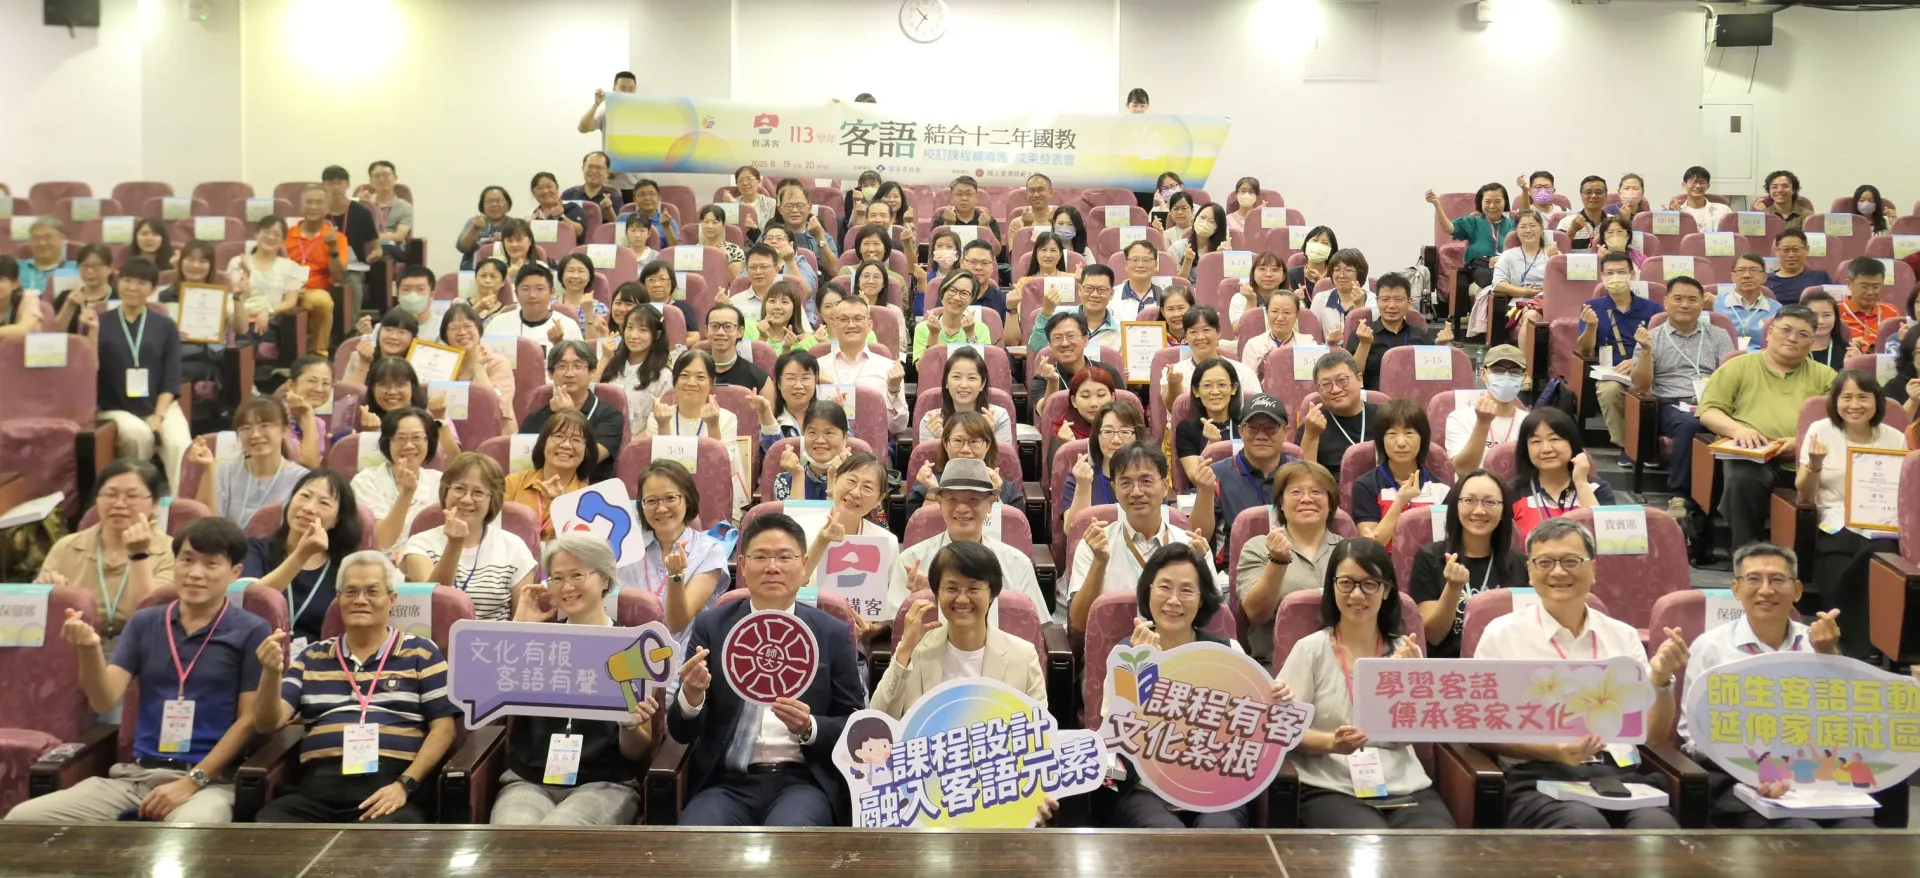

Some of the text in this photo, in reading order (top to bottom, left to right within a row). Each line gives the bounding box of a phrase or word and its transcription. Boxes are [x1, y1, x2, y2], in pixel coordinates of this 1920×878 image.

[839, 119, 917, 158] 客語
[923, 124, 1076, 150] 結合十二年國教
[1423, 356, 1442, 364] 5-15
[666, 445, 684, 455] 3-9
[1717, 607, 1746, 621] 保留
[470, 637, 572, 667] 文化有根
[763, 647, 778, 668] 師大
[496, 665, 598, 694] 客語有聲
[1375, 671, 1498, 700] 學習客語
[1707, 673, 1920, 715] 師生客語互動
[1144, 676, 1307, 747] 課程有客
[1388, 700, 1575, 731] 傳承客家文化
[890, 706, 1051, 782] 課程設計
[1708, 709, 1920, 751] 延伸家庭社區
[1104, 711, 1264, 780] 文化紮根
[859, 736, 1101, 827] 融入客語元素
